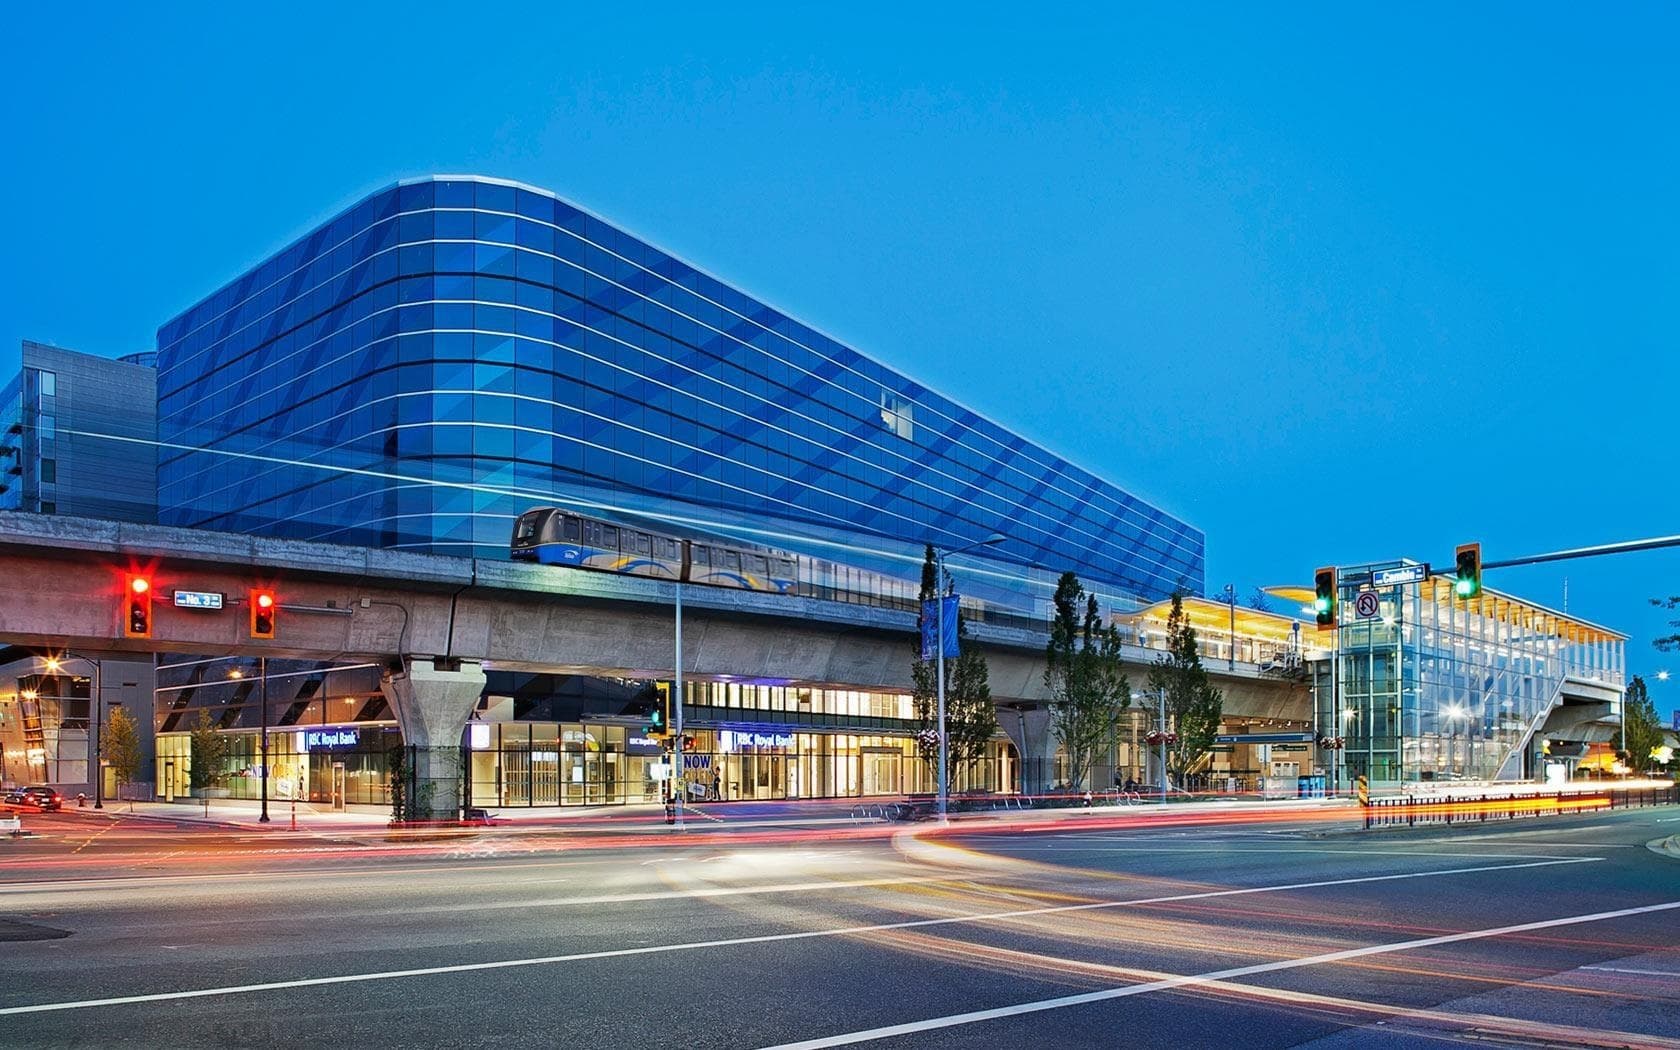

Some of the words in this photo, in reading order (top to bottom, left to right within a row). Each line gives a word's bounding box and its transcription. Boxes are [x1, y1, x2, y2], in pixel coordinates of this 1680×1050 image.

[1383, 569, 1415, 584] Cambie
[186, 594, 201, 605] No.
[203, 595, 211, 606] 3
[309, 732, 321, 746] RBC
[321, 732, 339, 748] Royal
[340, 731, 357, 745] Bank
[737, 732, 754, 746] RBC
[754, 733, 775, 748] Royal
[775, 733, 795, 746] Bank
[684, 755, 711, 768] NOW
